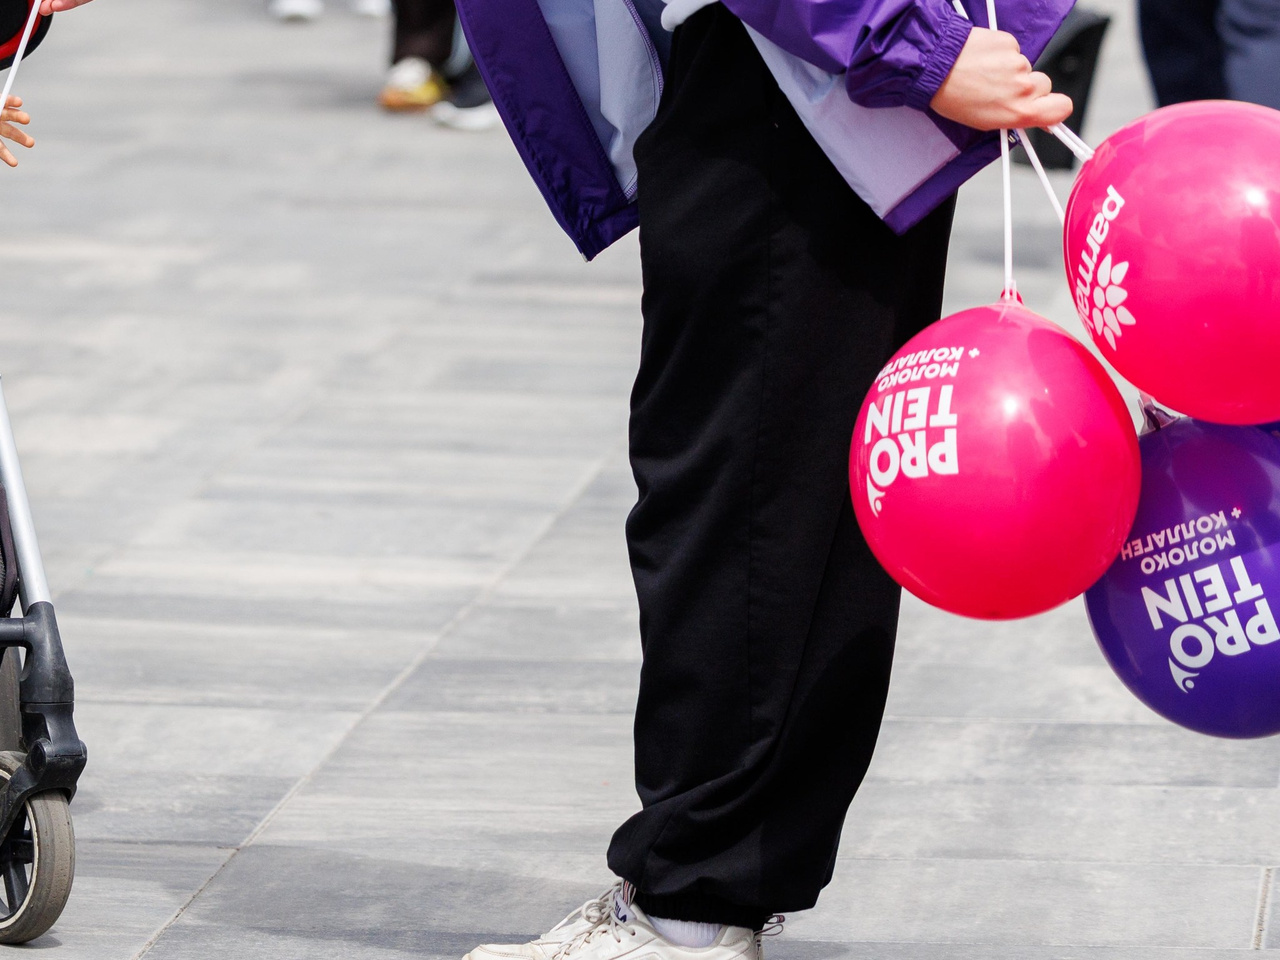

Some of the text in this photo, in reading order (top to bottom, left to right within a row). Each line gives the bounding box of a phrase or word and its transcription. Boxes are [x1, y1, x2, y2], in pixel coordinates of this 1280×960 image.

[1076, 184, 1125, 340] parmala
[878, 362, 959, 392] МОЛОКО
[864, 385, 958, 445] TEIN
[870, 428, 959, 487] PRO
[1121, 510, 1228, 561] КОЛЛАГЕН
[1140, 529, 1236, 575] МОЛОКО
[1140, 555, 1264, 630] TEIN
[1170, 598, 1280, 668] PRO
